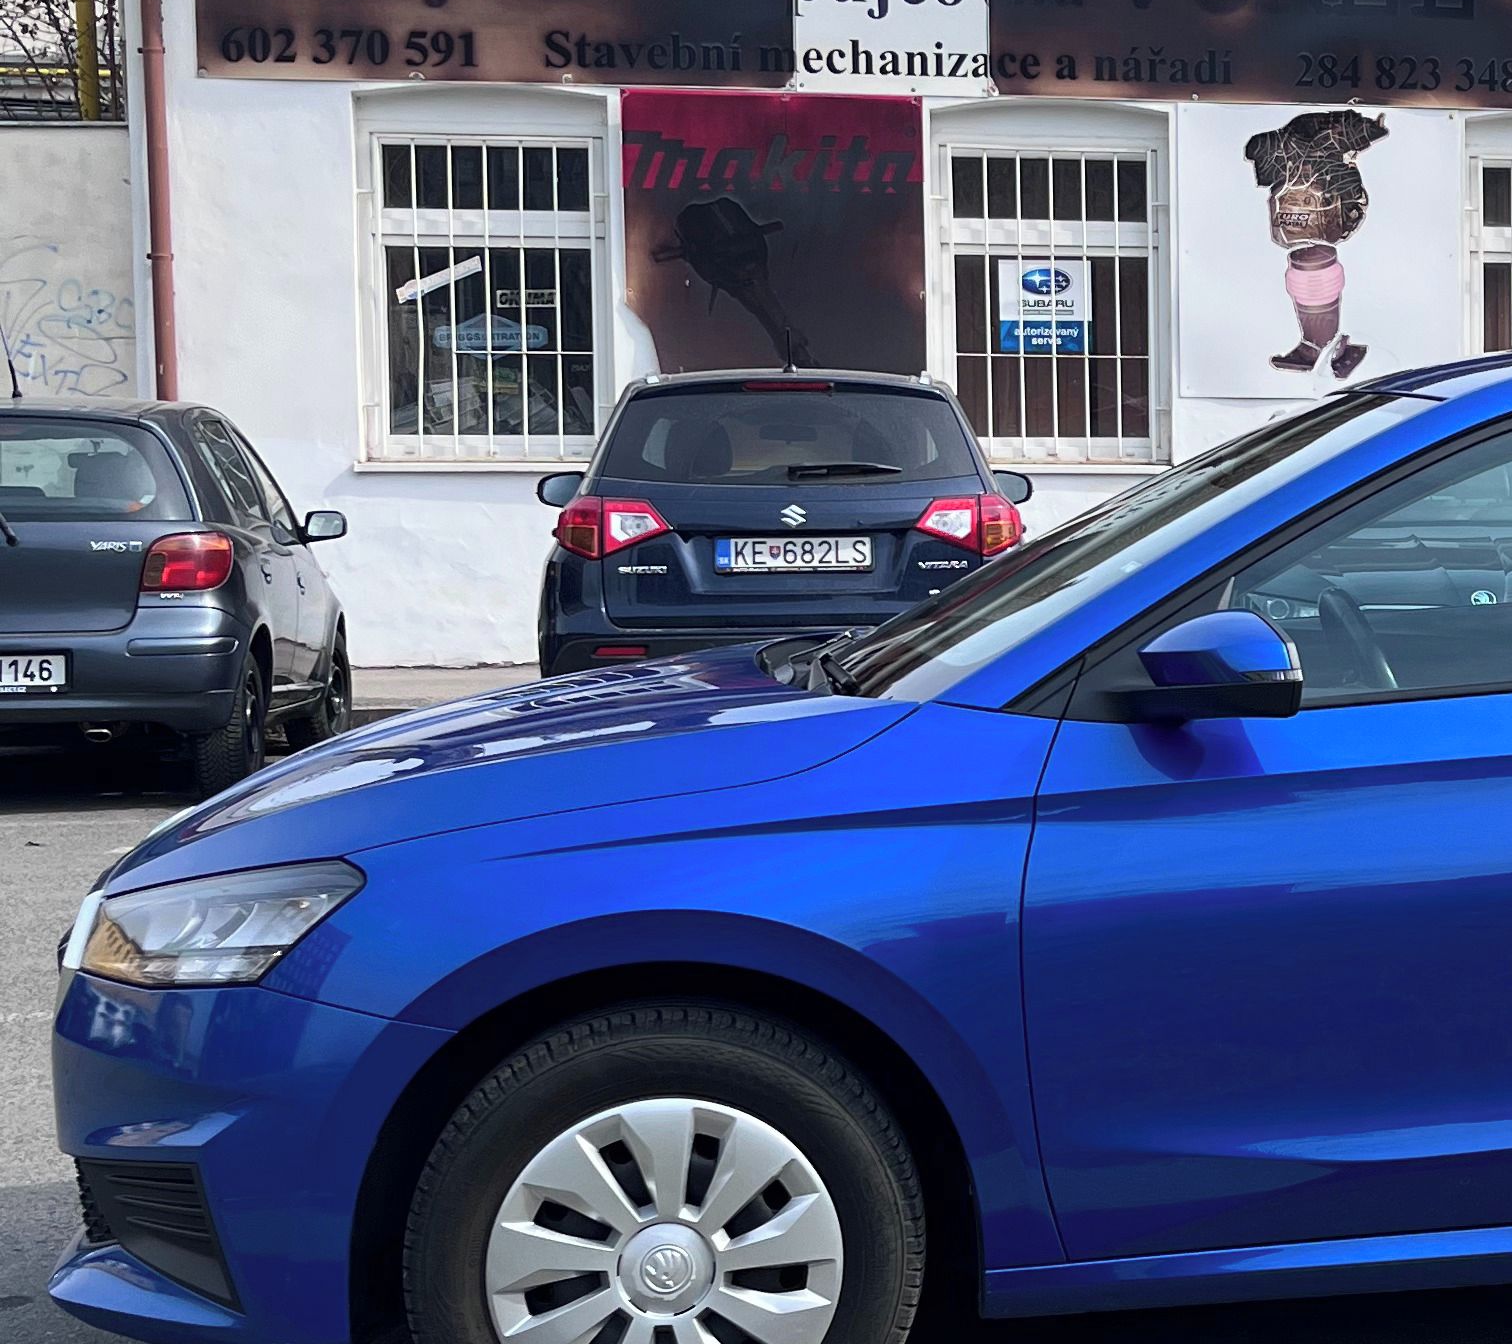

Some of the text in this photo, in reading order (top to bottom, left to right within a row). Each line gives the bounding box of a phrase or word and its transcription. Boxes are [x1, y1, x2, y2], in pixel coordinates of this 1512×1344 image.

[221, 27, 297, 63] 602
[312, 29, 389, 65] 370
[405, 31, 478, 67] 591
[544, 30, 743, 72] Stavební
[758, 38, 1041, 80] mechanizace
[1055, 54, 1079, 81] a
[1093, 46, 1234, 85] nářadí
[1295, 52, 1361, 89] 284
[1375, 56, 1442, 91] 823
[1031, 338, 1063, 346] servs
[734, 540, 867, 565] KE 682LS
[0, 659, 53, 682] 146
